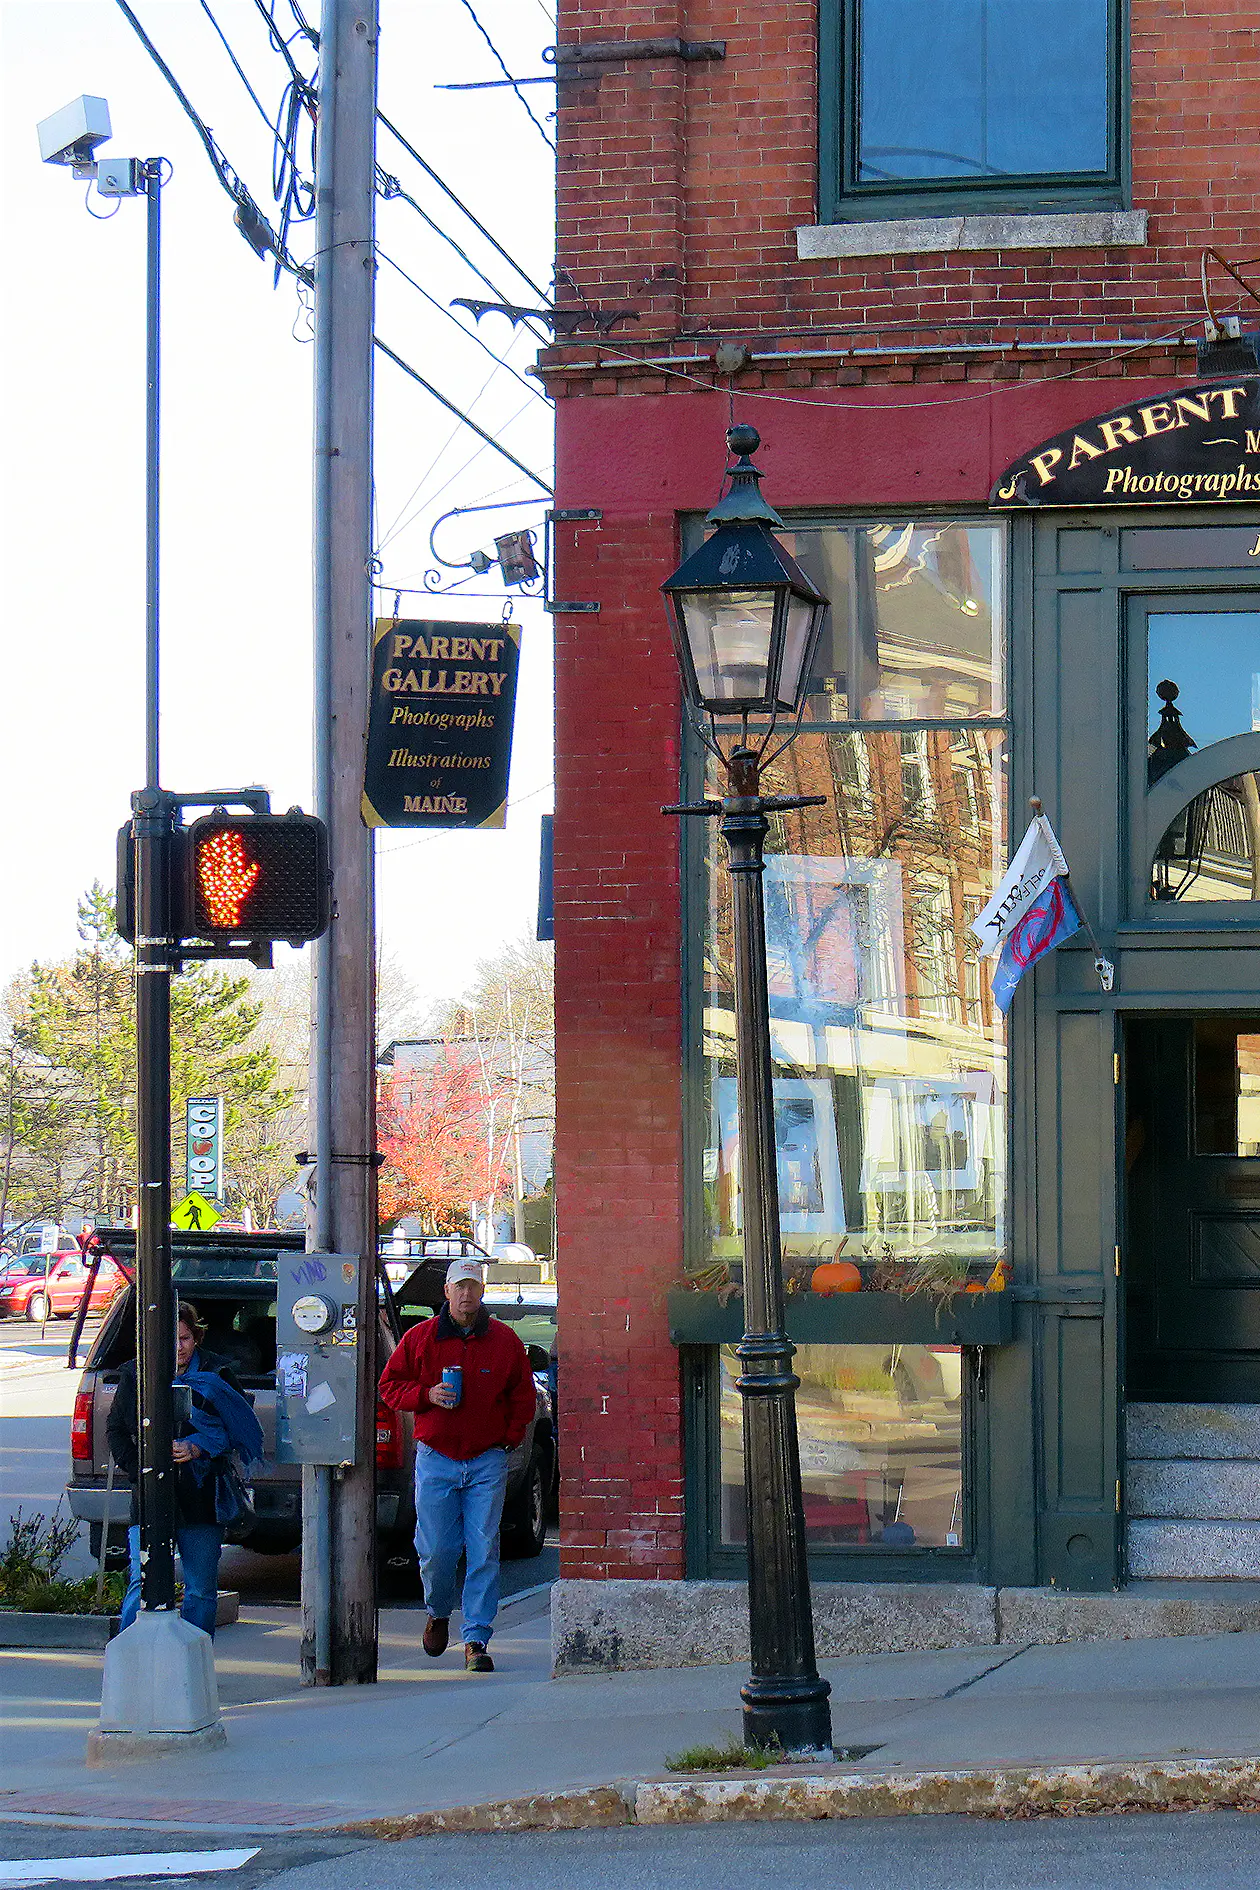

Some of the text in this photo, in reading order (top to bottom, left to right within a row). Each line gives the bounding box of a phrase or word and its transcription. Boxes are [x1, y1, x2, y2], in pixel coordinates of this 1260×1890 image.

[1029, 385, 1247, 487] PARENT
[392, 635, 505, 662] PARENT
[380, 668, 509, 696] GALLERY
[389, 706, 496, 731] Photographs
[387, 749, 492, 769] Illustrations
[429, 776, 444, 789] of
[403, 794, 469, 814] MAINE
